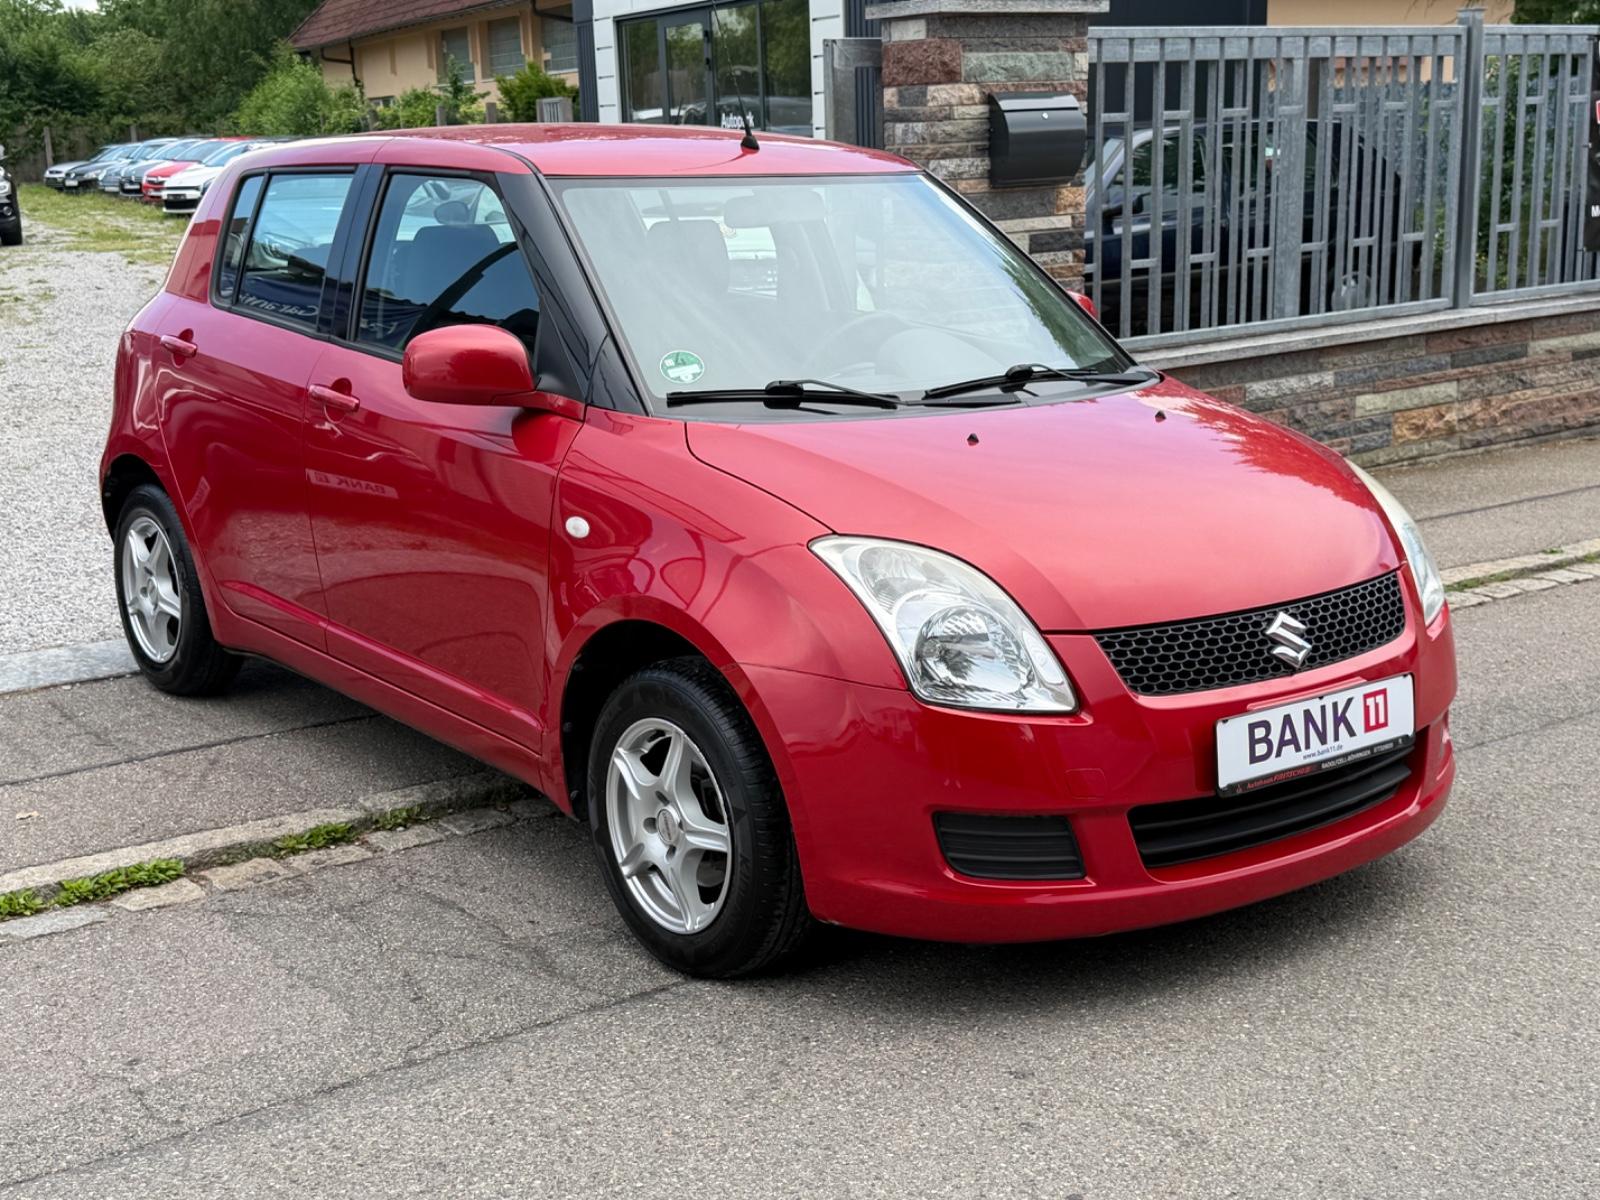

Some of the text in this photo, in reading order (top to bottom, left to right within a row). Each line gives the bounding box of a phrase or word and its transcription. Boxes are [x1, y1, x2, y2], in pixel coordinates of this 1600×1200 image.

[1247, 692, 1387, 765] BANK 11
[1302, 744, 1344, 761] www.bank11.de
